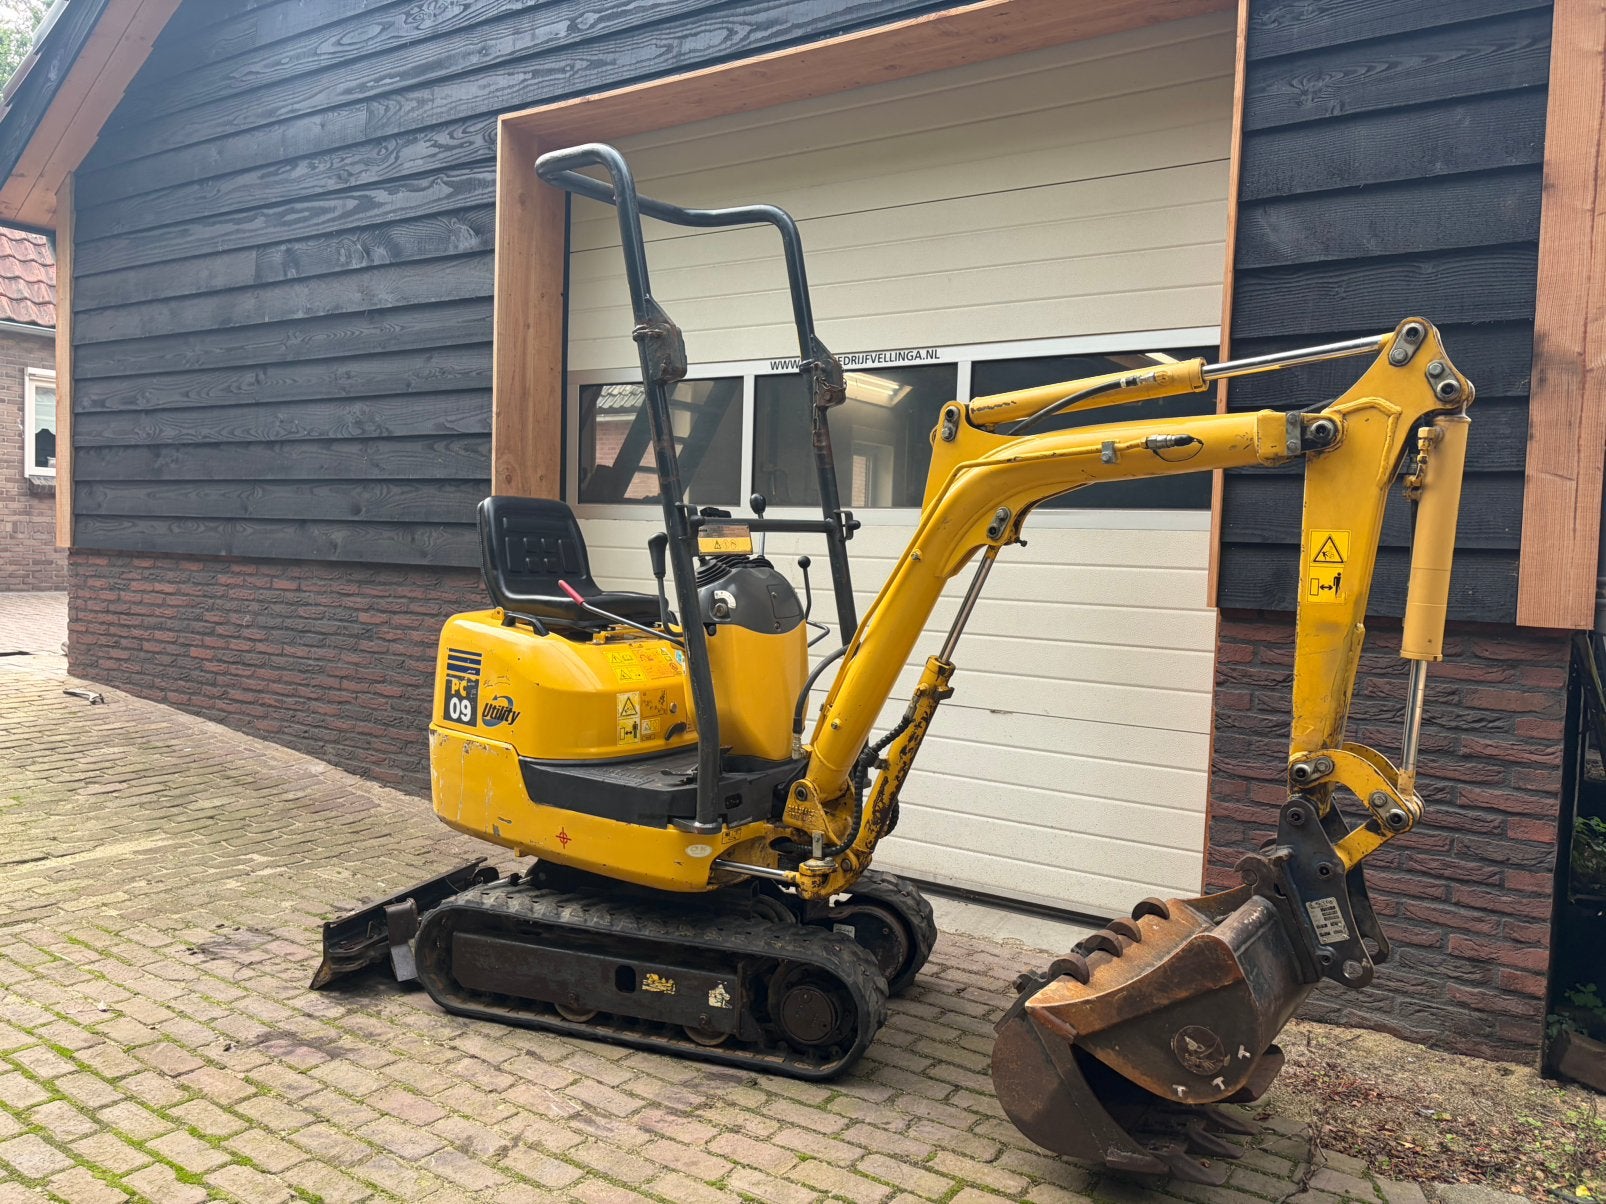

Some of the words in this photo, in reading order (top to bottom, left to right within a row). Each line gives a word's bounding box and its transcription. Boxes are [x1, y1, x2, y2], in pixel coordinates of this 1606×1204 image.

[770, 349, 940, 371] WWWEDRIJFVELLINGA.NL
[449, 697, 472, 722] 09
[482, 702, 521, 726] Utility
